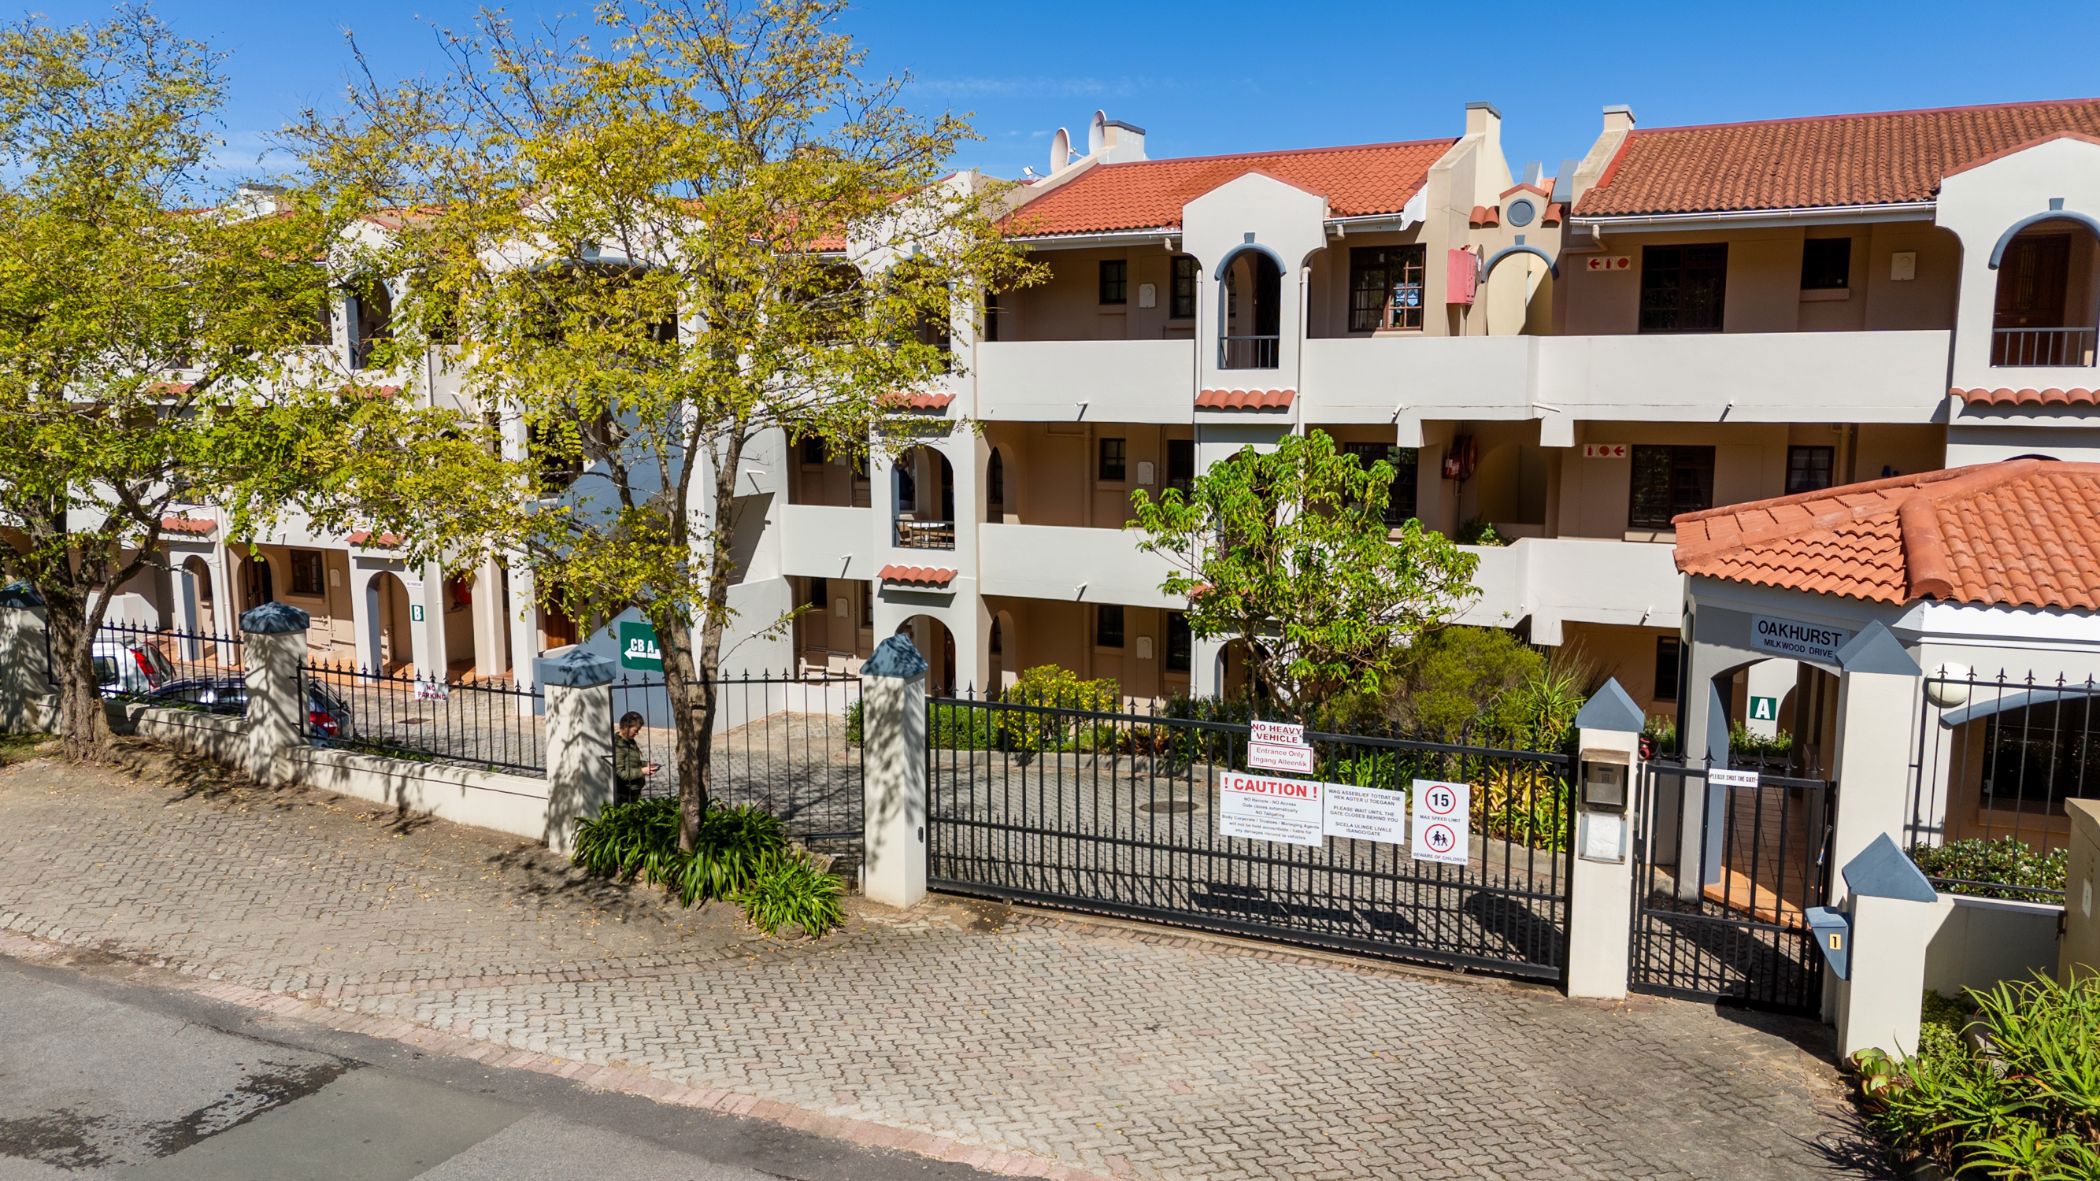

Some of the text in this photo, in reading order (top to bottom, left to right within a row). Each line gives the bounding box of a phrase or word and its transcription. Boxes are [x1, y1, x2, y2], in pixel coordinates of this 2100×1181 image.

[414, 606, 421, 620] B
[1758, 621, 1842, 646] OAKHURST
[1764, 639, 1833, 658] MILKWOOD DRIVE
[1755, 699, 1770, 719] A
[1270, 726, 1302, 734] HEAVY
[1257, 734, 1298, 743] VEHICLE
[1253, 756, 1276, 765] Ingang
[1234, 778, 1307, 797] CAUTION
[1432, 794, 1449, 807] 15
